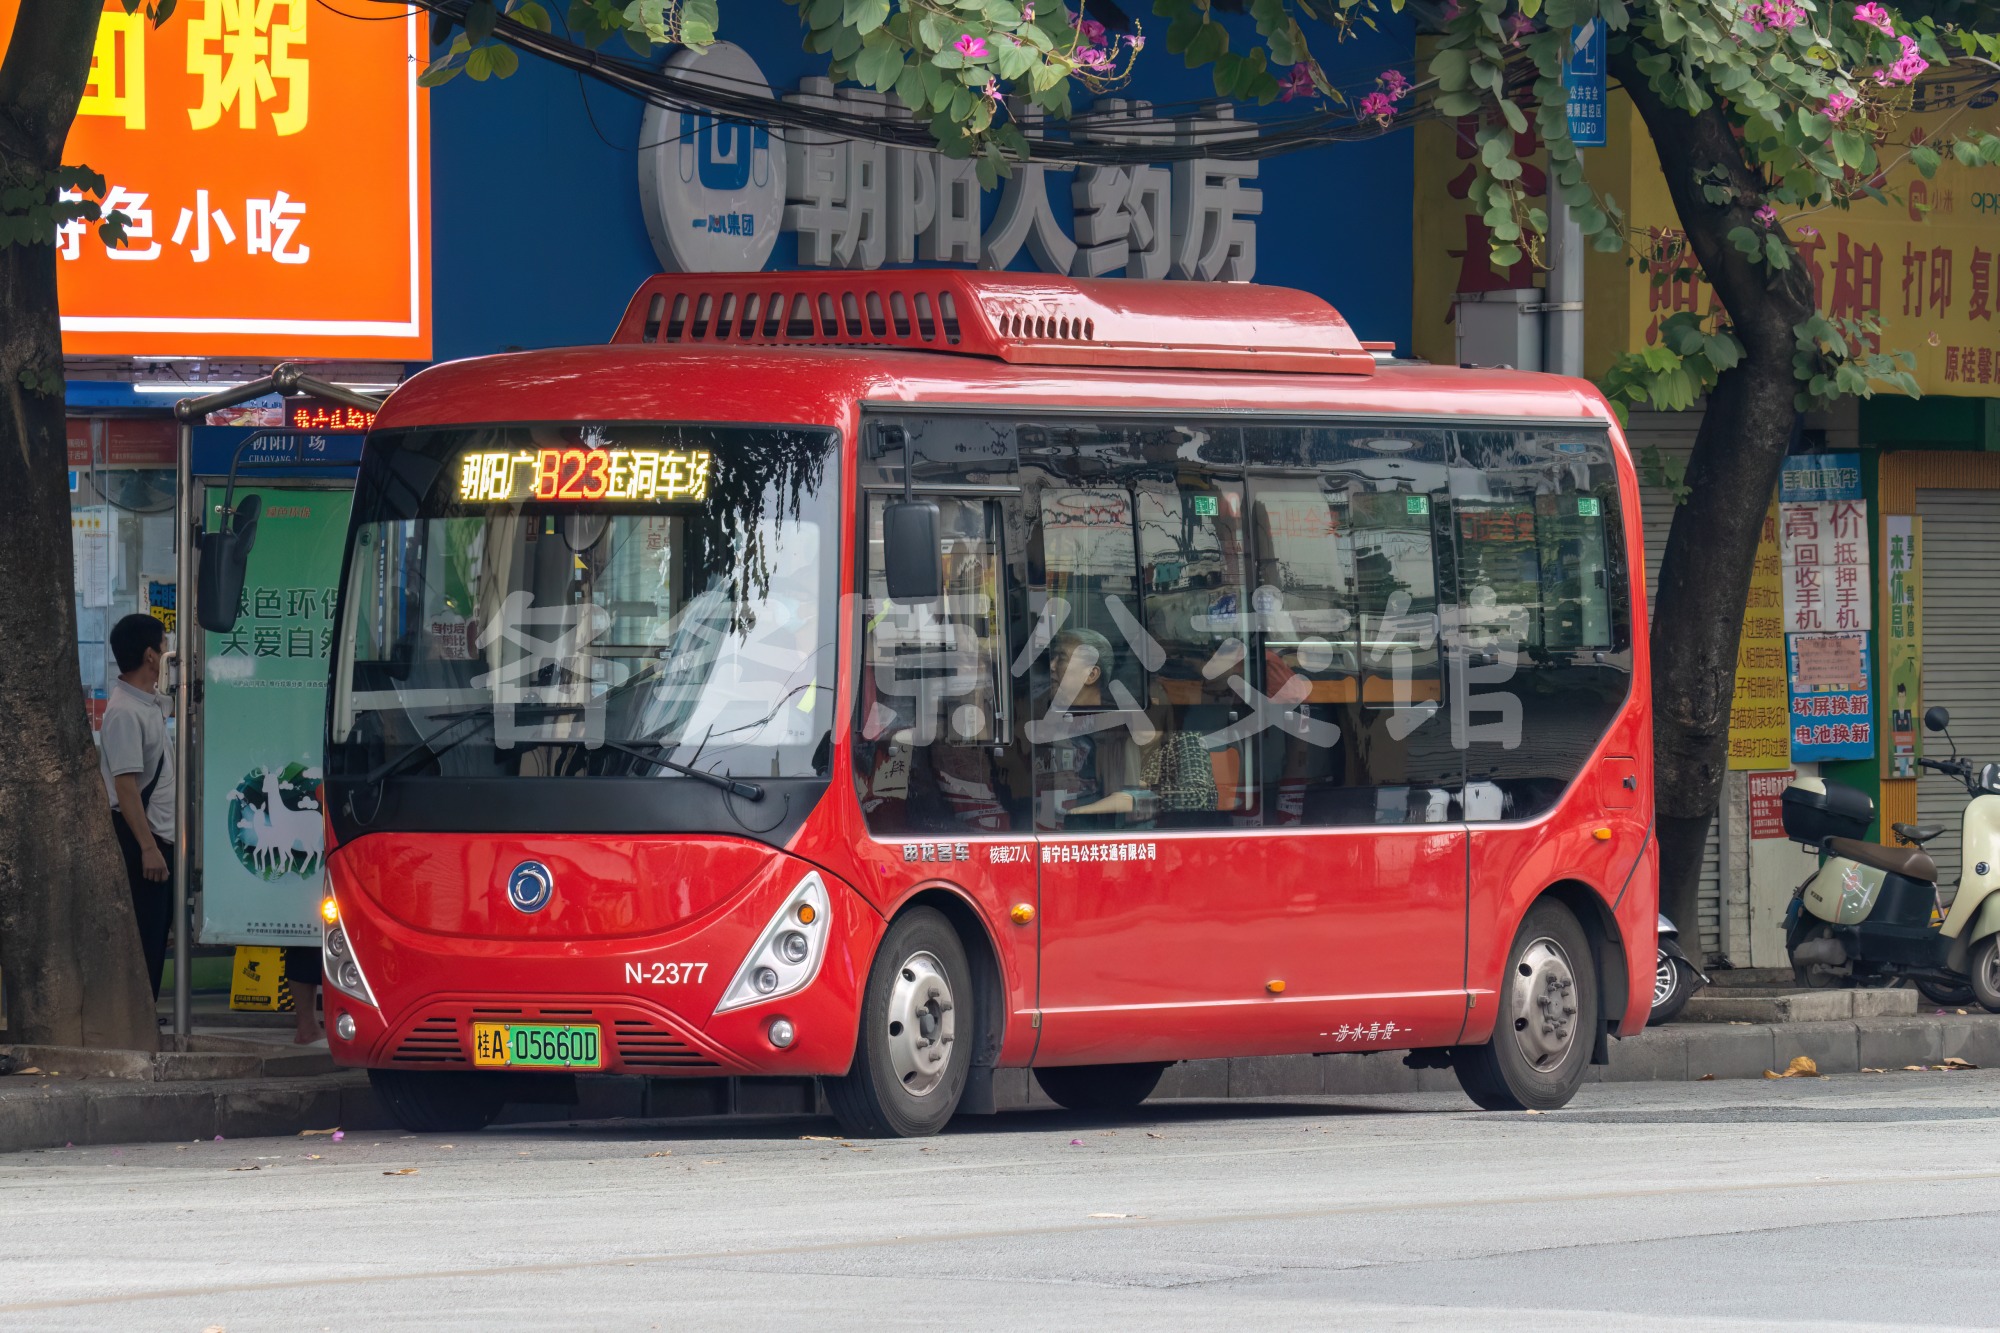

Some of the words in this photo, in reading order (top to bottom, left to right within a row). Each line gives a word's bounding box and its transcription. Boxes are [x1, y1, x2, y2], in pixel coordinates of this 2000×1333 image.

[1569, 85, 1599, 100] 公共安全
[1566, 103, 1602, 118] 视频监控区
[1572, 121, 1597, 134] VIDEO
[782, 76, 1263, 283] 朝阳大药房
[1902, 241, 1953, 319] 打印
[1968, 245, 2000, 322] 复
[536, 449, 610, 499] B23
[605, 449, 710, 500] 玉洞车场
[1781, 468, 1858, 490] 手机配件
[1783, 503, 1864, 540] 高价
[1794, 543, 1821, 630] 回收手机
[1834, 541, 1859, 630] 抵押手机
[1890, 534, 1905, 638] 来休息
[1732, 676, 1785, 699] 子相册制作
[1792, 694, 1869, 716] 坏屏换新
[1795, 723, 1871, 746] 电池换新
[989, 845, 1031, 864] 核载27人
[1041, 843, 1157, 864] 南宁白马公共交通有限公司
[625, 962, 709, 984] N-2377
[1336, 1021, 1396, 1042] 涉水高度
